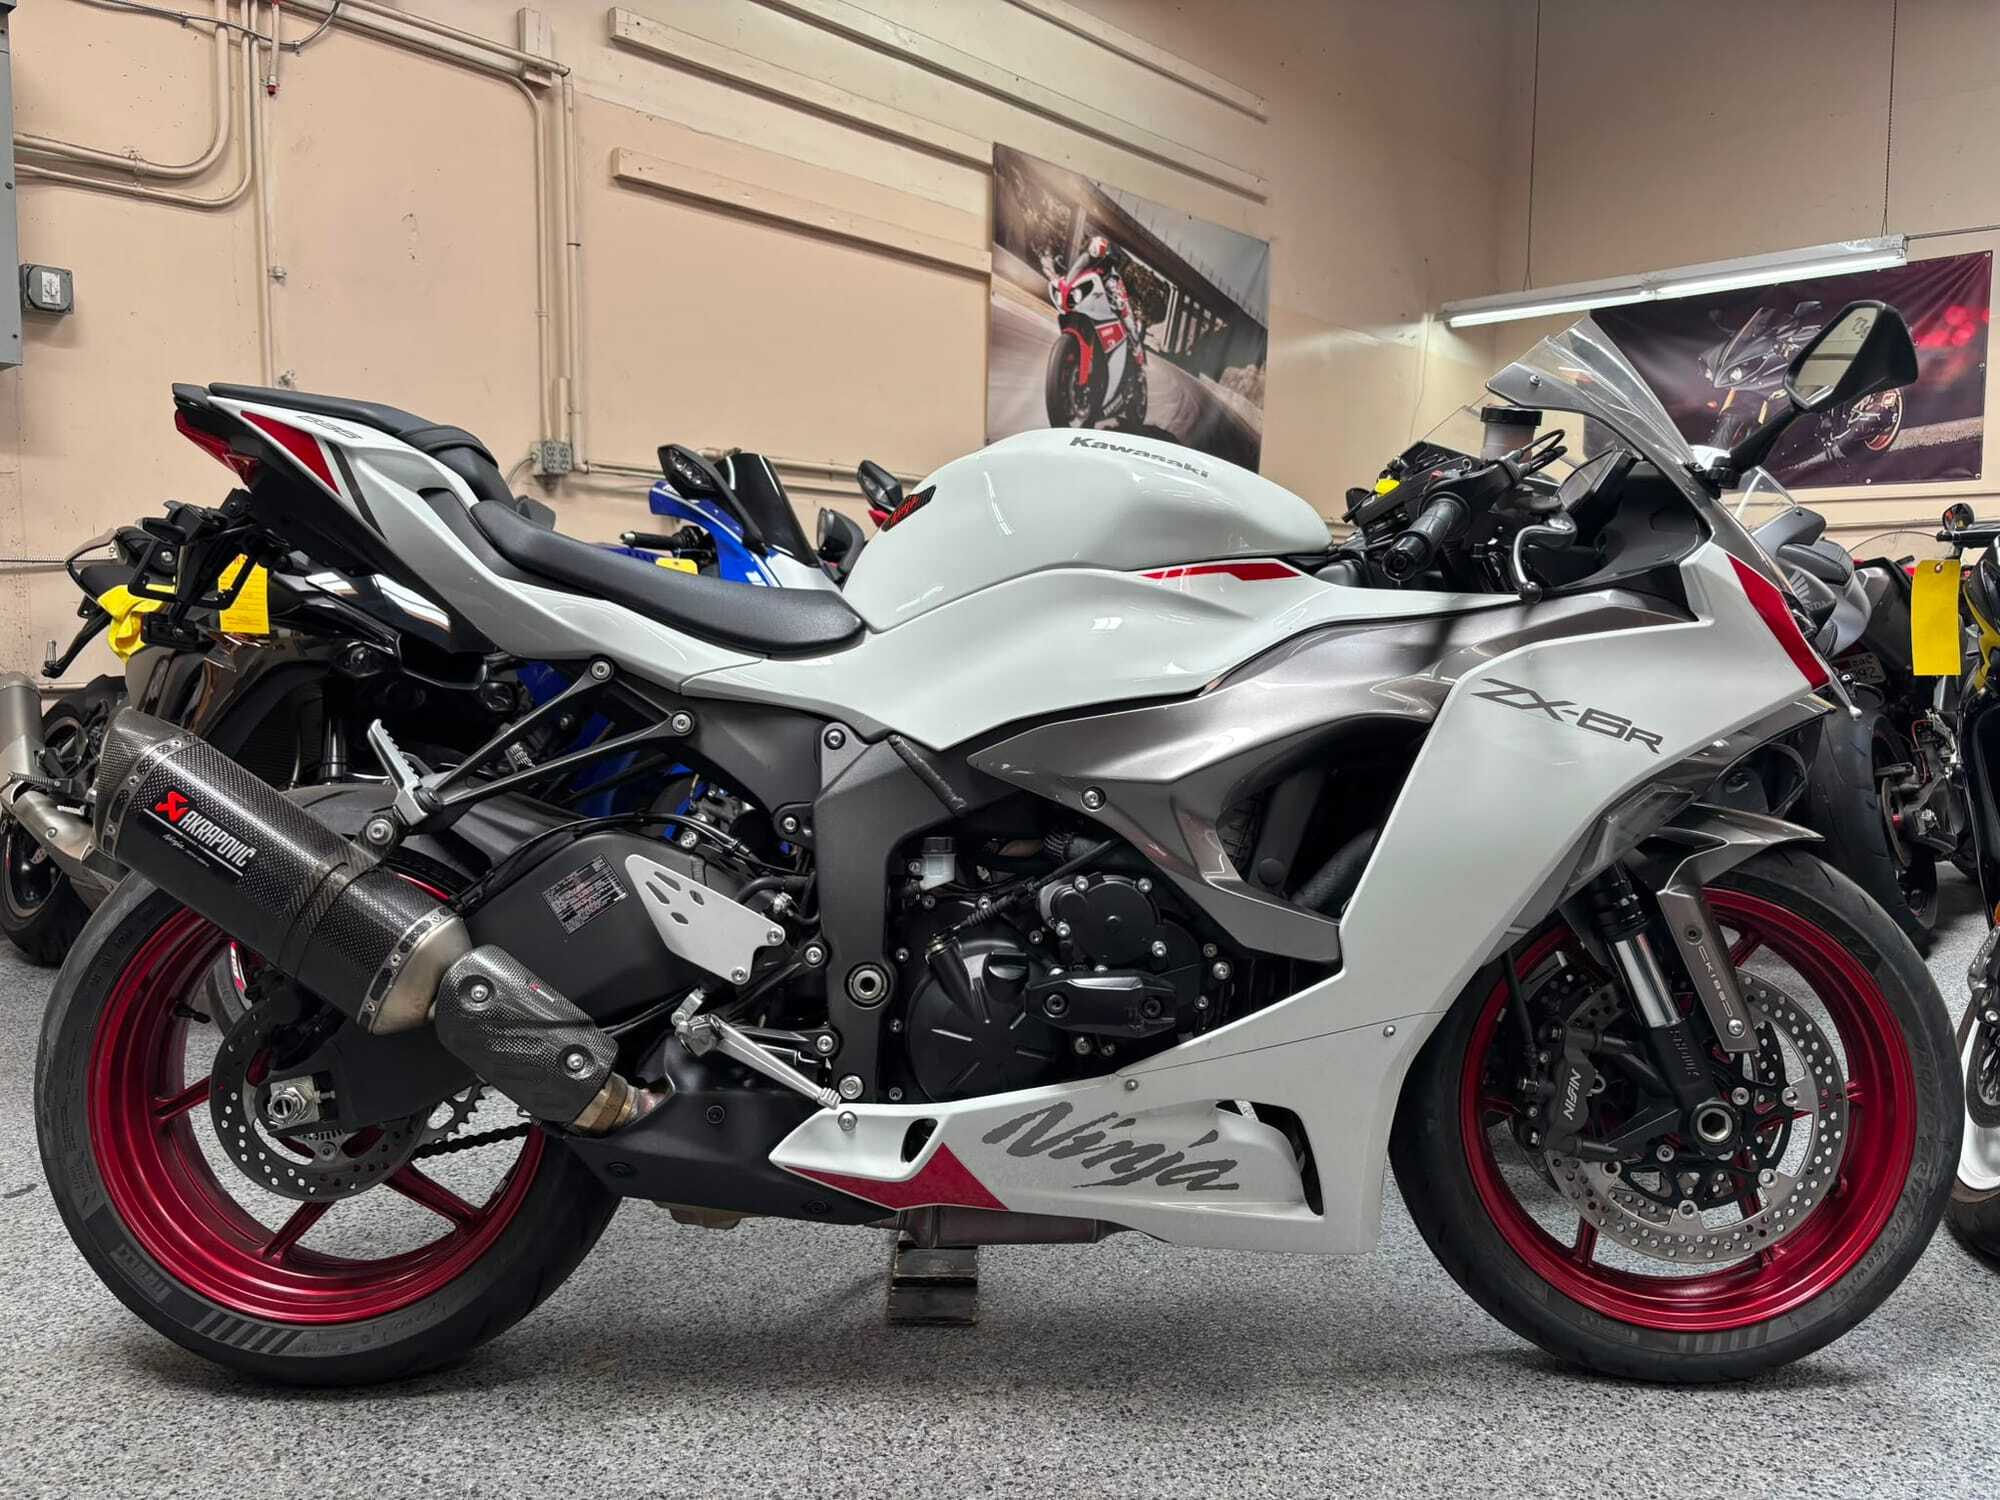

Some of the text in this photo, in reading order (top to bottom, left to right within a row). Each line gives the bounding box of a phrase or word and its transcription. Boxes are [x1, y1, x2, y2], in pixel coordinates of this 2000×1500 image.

[1069, 436, 1209, 478] Kawasaki
[1470, 678, 1664, 755] ZX-6R
[1562, 1067, 1582, 1121] NISSIN
[981, 1101, 1240, 1192] Ninja
